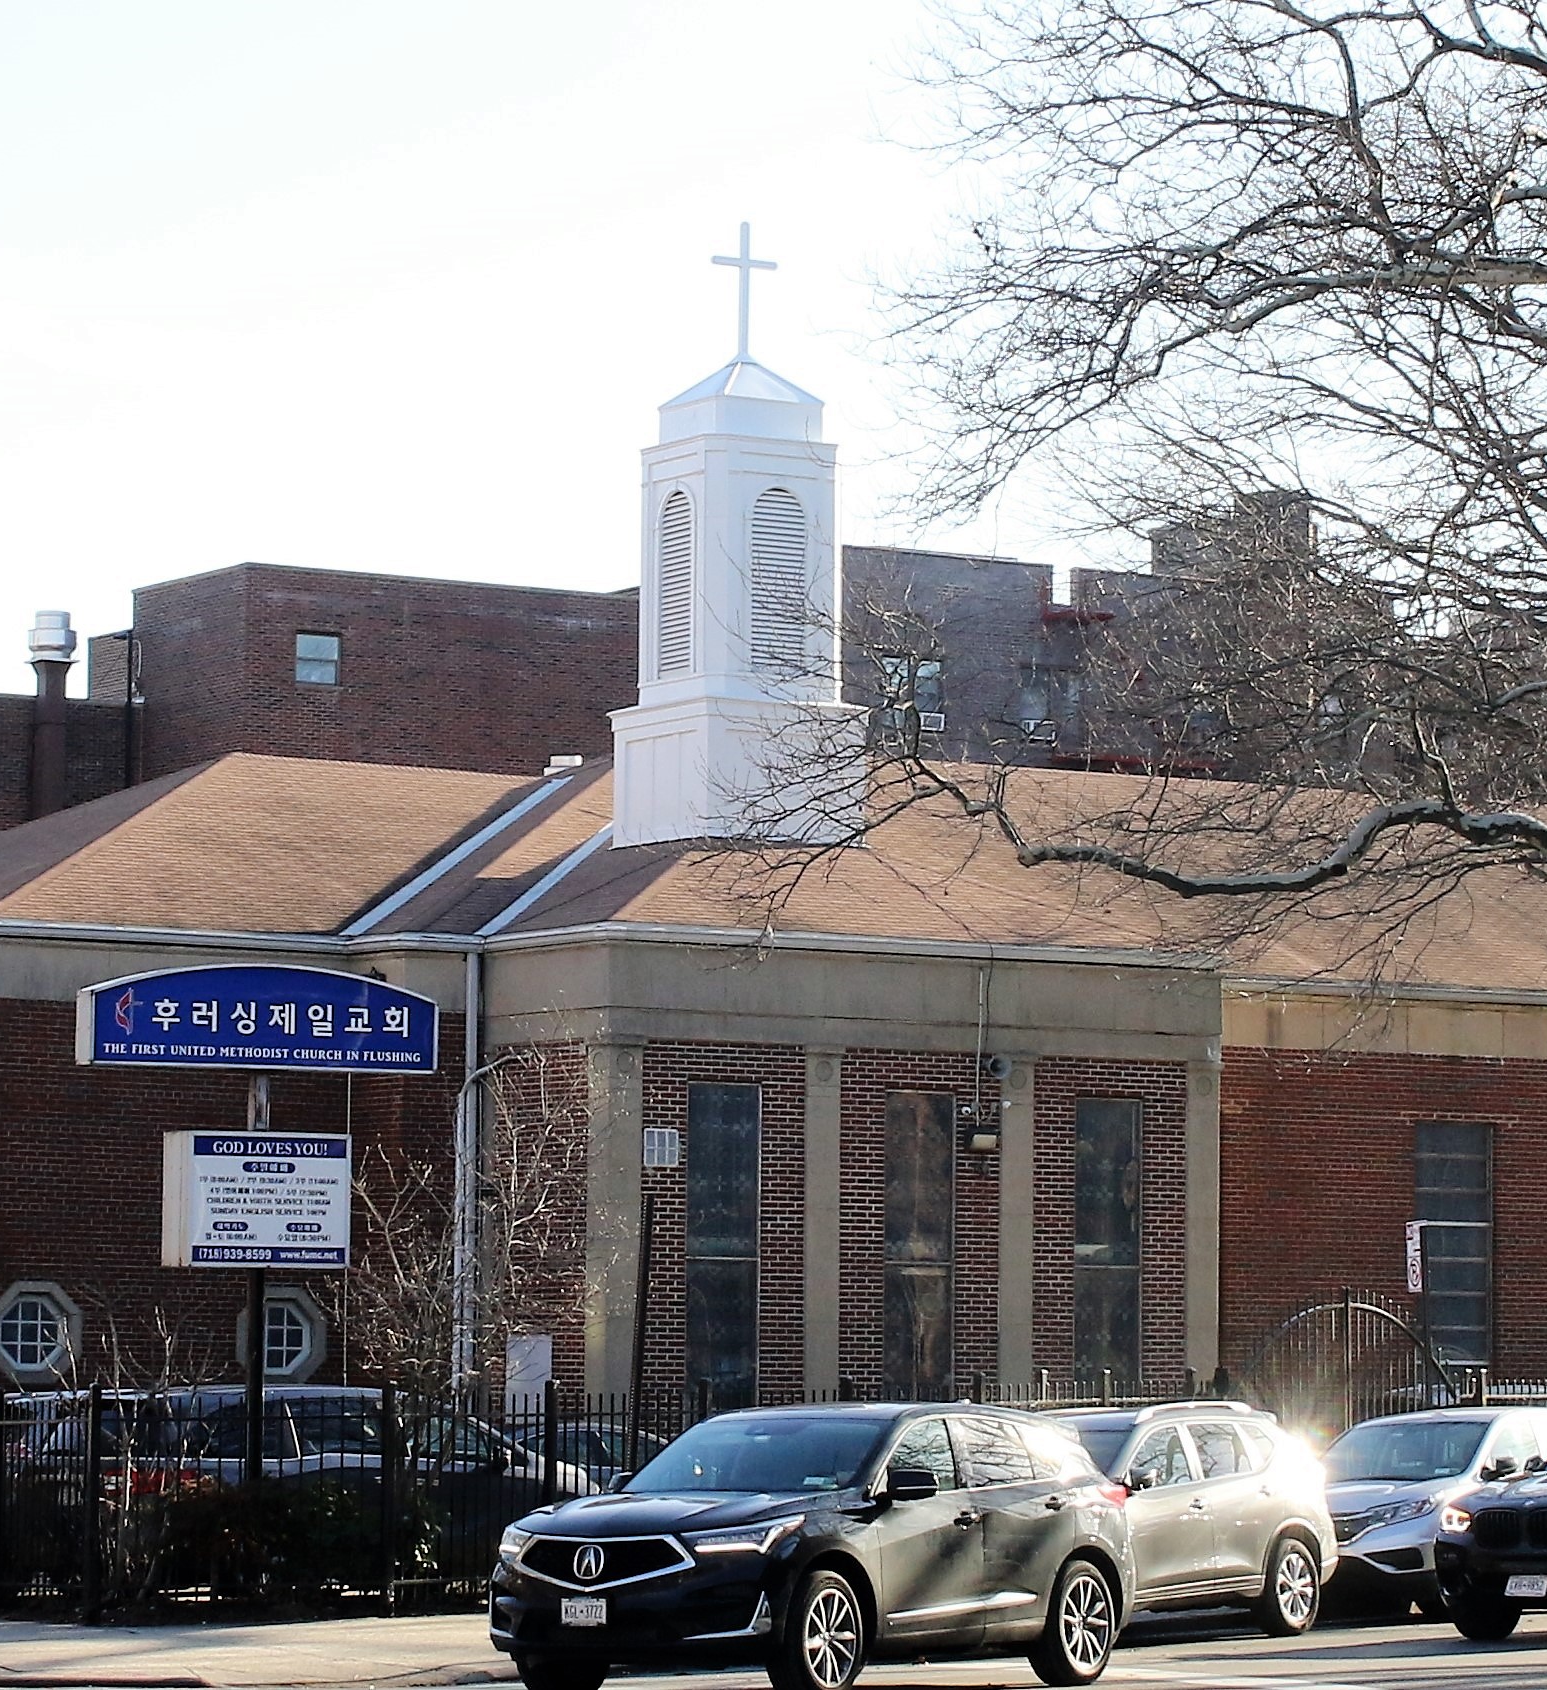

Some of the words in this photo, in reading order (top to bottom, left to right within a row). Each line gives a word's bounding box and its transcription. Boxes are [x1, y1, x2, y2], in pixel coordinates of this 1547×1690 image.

[152, 998, 410, 1038] 후러싱제일교회
[103, 1042, 128, 1055] THE
[131, 1043, 165, 1056] FIRST
[170, 1044, 216, 1057] UNITED
[219, 1046, 289, 1059] METHODIST
[293, 1048, 343, 1061] CHURCH
[346, 1049, 359, 1061] IN
[363, 1050, 422, 1063] FLUSHING
[212, 1140, 244, 1154] GOD
[247, 1141, 292, 1155] LOVES
[294, 1143, 328, 1156] YOU!
